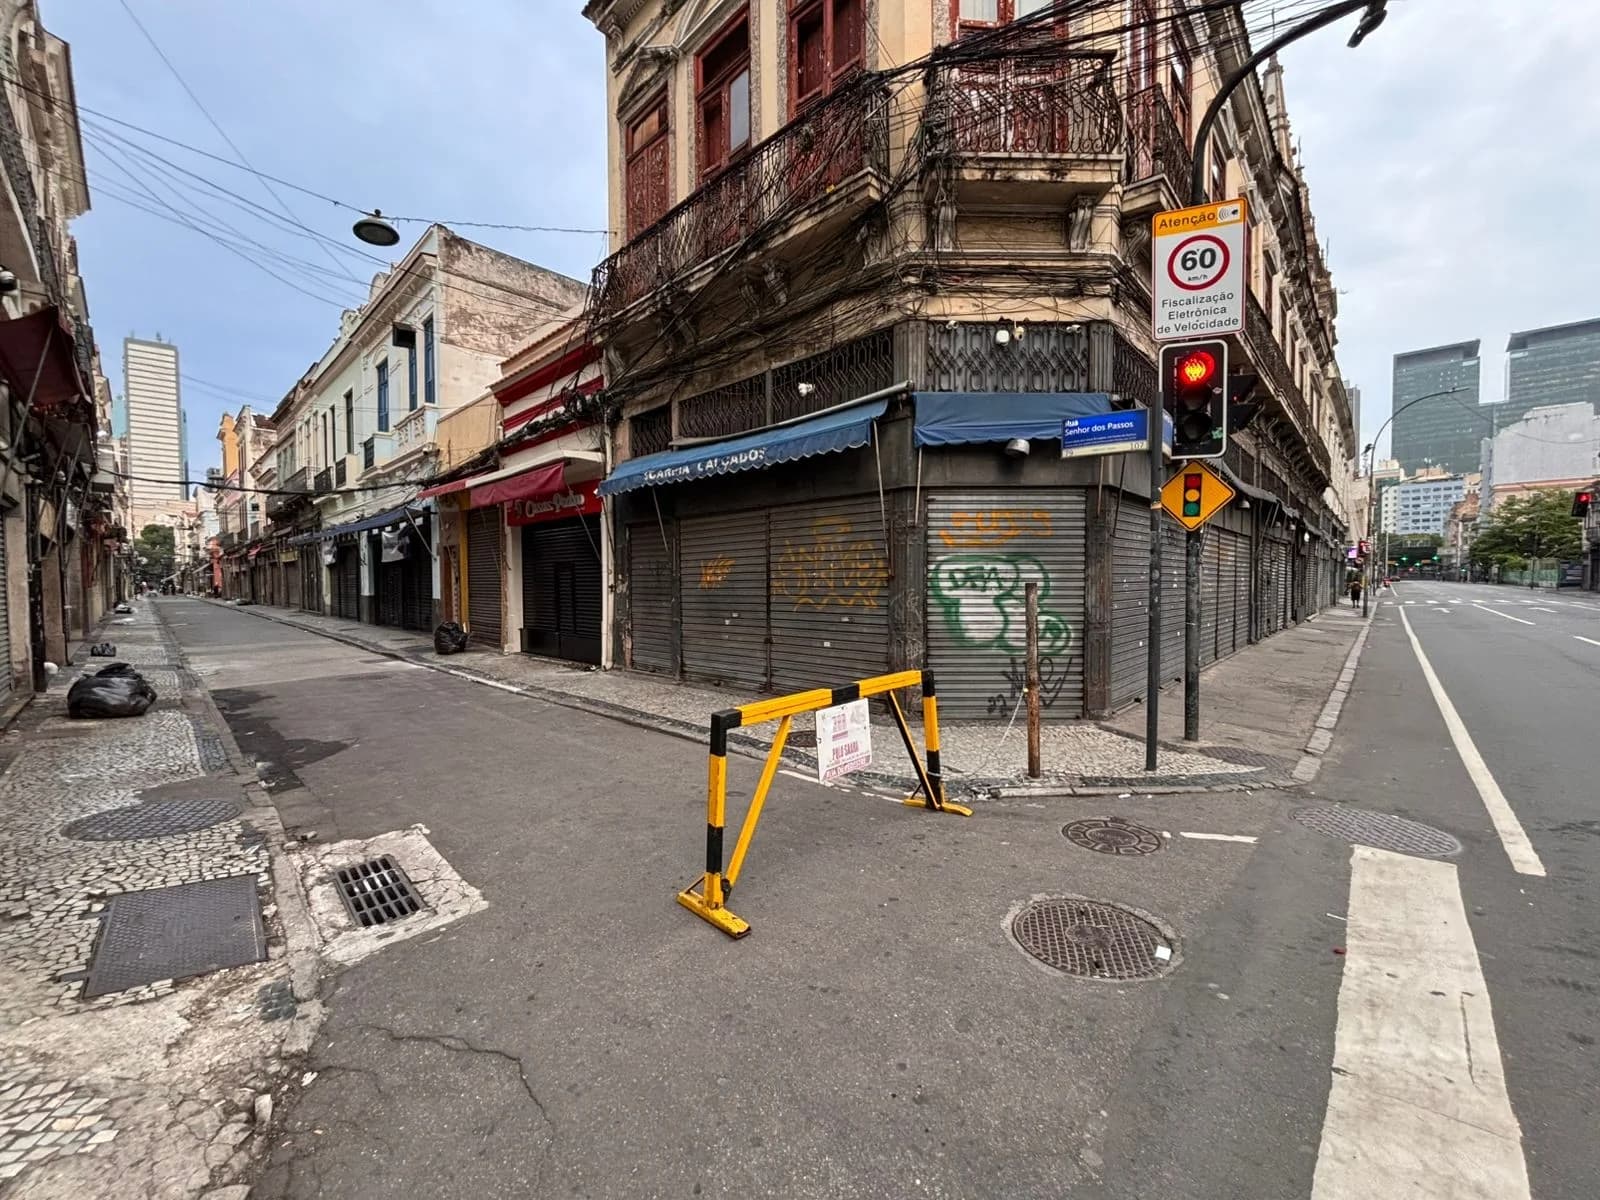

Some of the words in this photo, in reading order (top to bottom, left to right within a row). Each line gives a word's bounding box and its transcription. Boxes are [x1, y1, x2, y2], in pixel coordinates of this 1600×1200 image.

[1159, 211, 1216, 229] Atenção
[1181, 247, 1217, 271] 60
[1187, 273, 1208, 281] km/h
[1161, 291, 1234, 308] Fiscalização
[1168, 306, 1227, 320] Eletrônica
[1156, 324, 1171, 334] de
[1174, 317, 1239, 333] Velocidade
[1065, 427, 1090, 437] Senhor
[1091, 424, 1105, 432] dos
[1107, 421, 1134, 430] Passos
